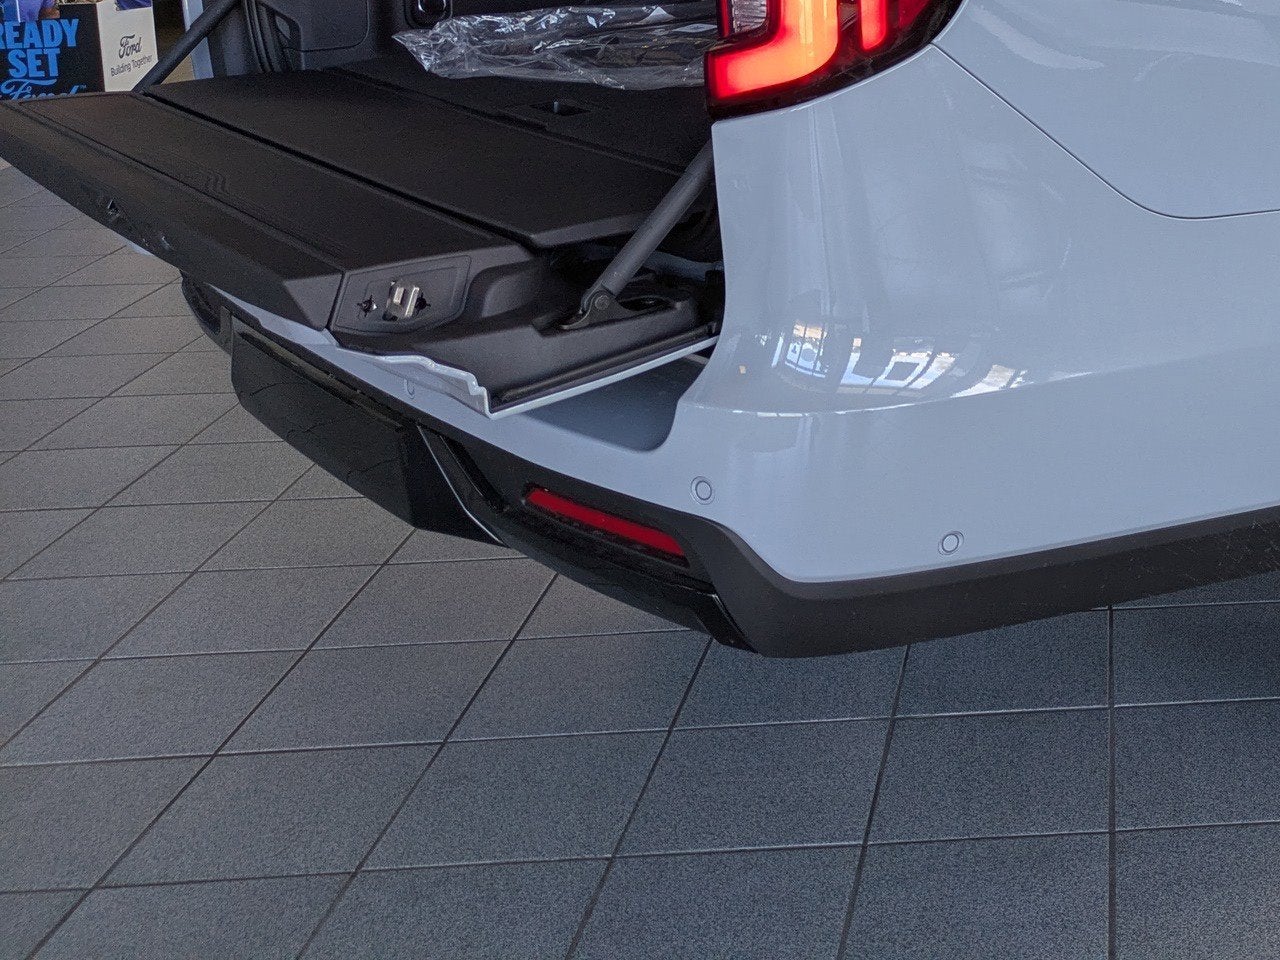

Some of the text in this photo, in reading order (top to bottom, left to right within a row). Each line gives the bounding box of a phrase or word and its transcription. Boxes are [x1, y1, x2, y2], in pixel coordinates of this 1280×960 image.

[118, 33, 142, 59] Ford
[7, 48, 60, 78] SET
[110, 54, 153, 77] Building Together
